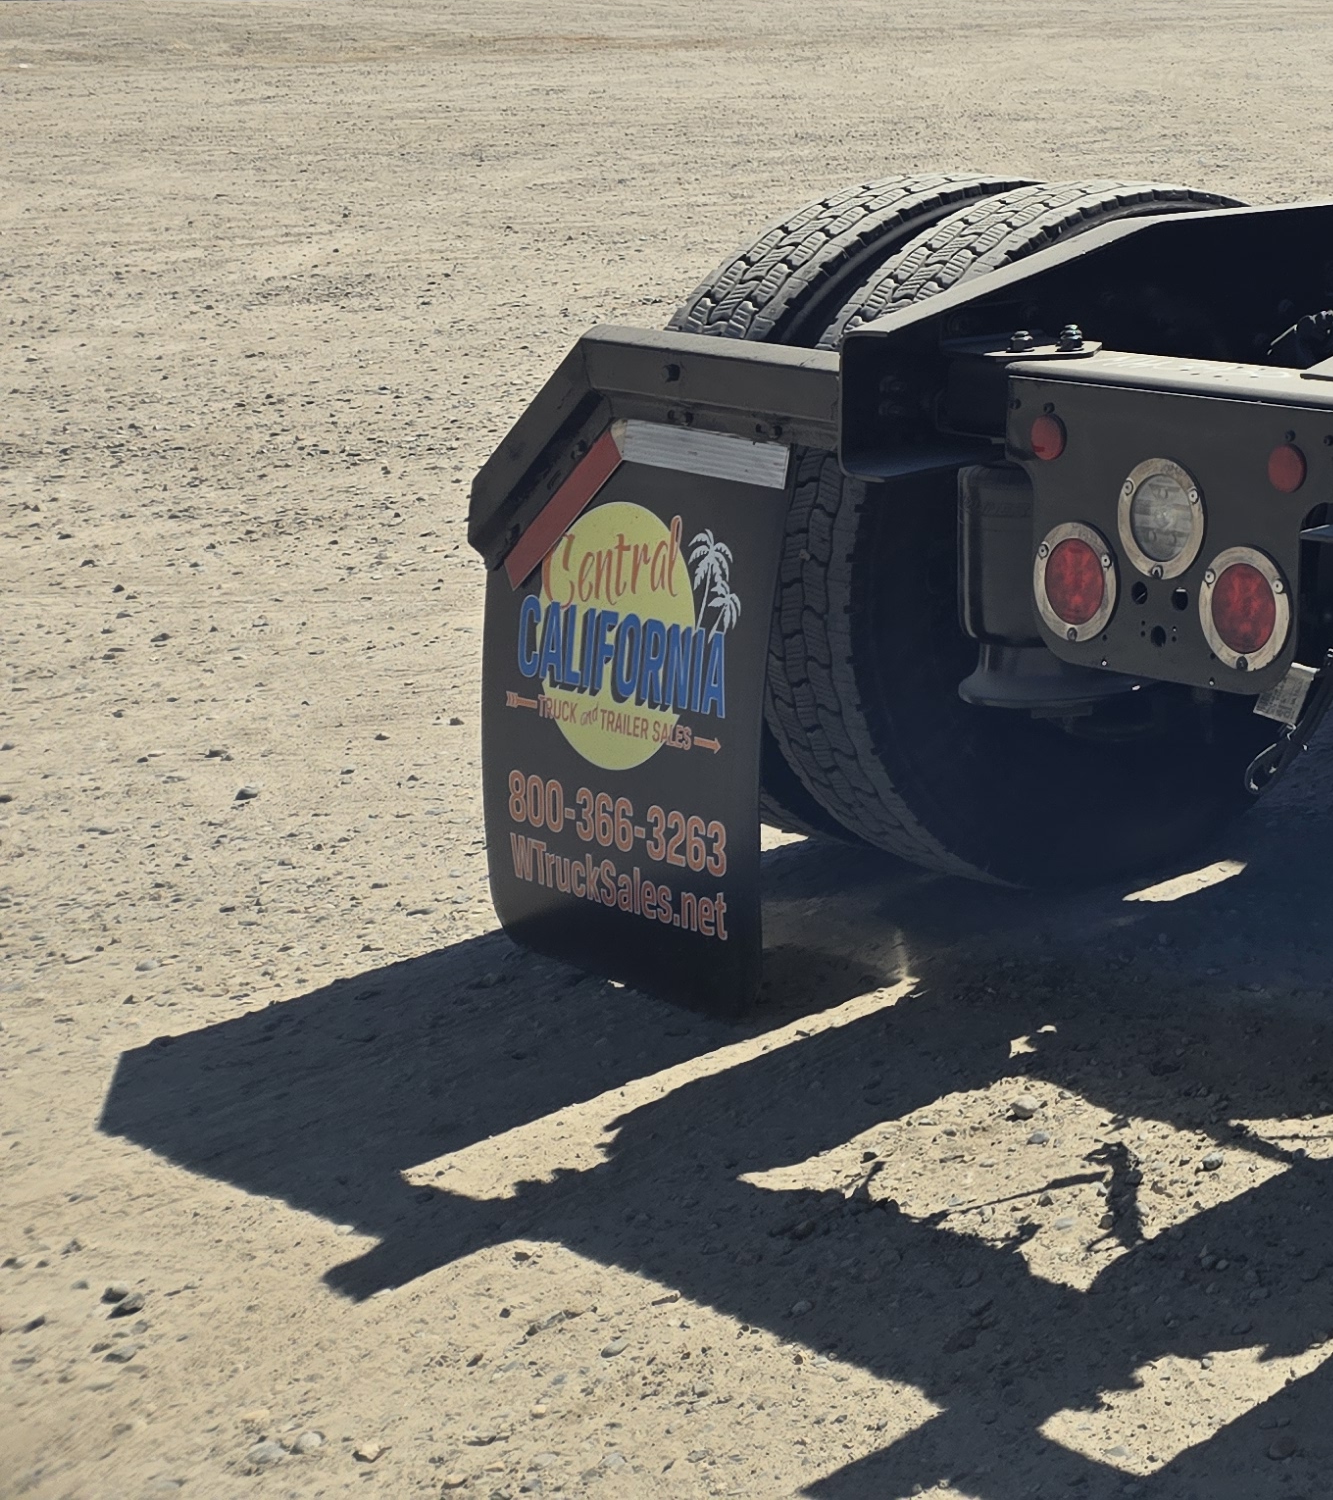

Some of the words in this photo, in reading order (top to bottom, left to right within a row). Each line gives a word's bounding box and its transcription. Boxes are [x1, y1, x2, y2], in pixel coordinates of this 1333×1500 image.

[542, 515, 682, 610] Central
[518, 594, 726, 718] CALIFORNIA
[538, 694, 577, 724] TRUCK
[581, 704, 599, 726] and
[600, 709, 649, 740] TRAILER
[652, 721, 692, 750] SALES
[508, 769, 728, 877] 800-366-3263
[509, 832, 728, 941] WTruckSales.net
